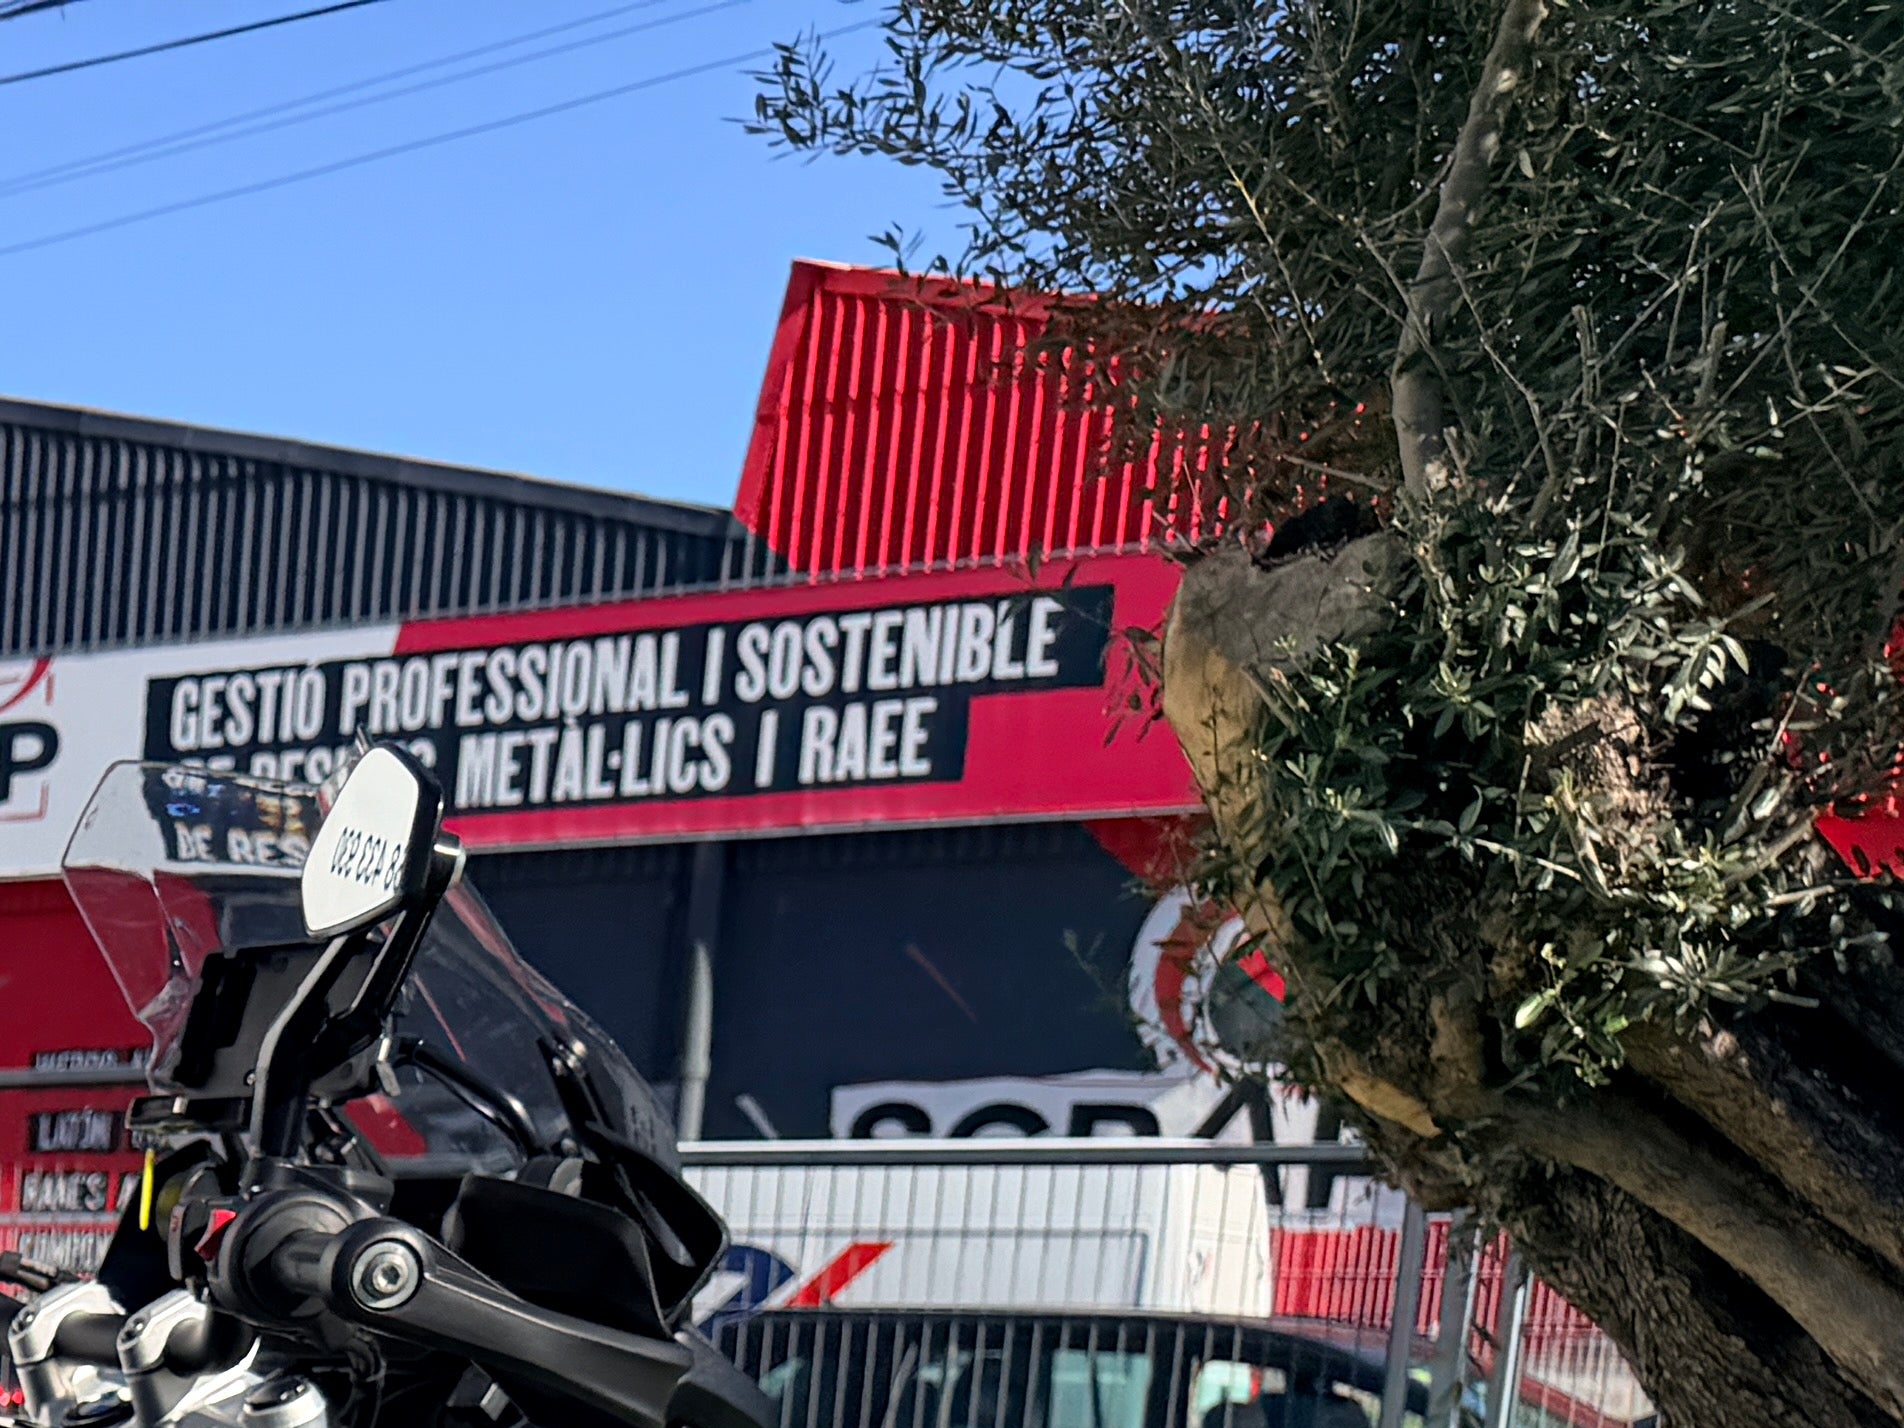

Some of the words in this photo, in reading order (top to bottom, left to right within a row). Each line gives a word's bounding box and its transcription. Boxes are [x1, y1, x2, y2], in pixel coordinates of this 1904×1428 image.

[169, 660, 326, 752] GESTIÓ
[339, 634, 690, 736] PROFESSIONAL
[701, 628, 726, 705] I
[735, 597, 1064, 702] SOSTENIBLE
[454, 711, 734, 808] METÀL·LICS
[755, 708, 780, 787] I
[798, 697, 939, 784] RAEE
